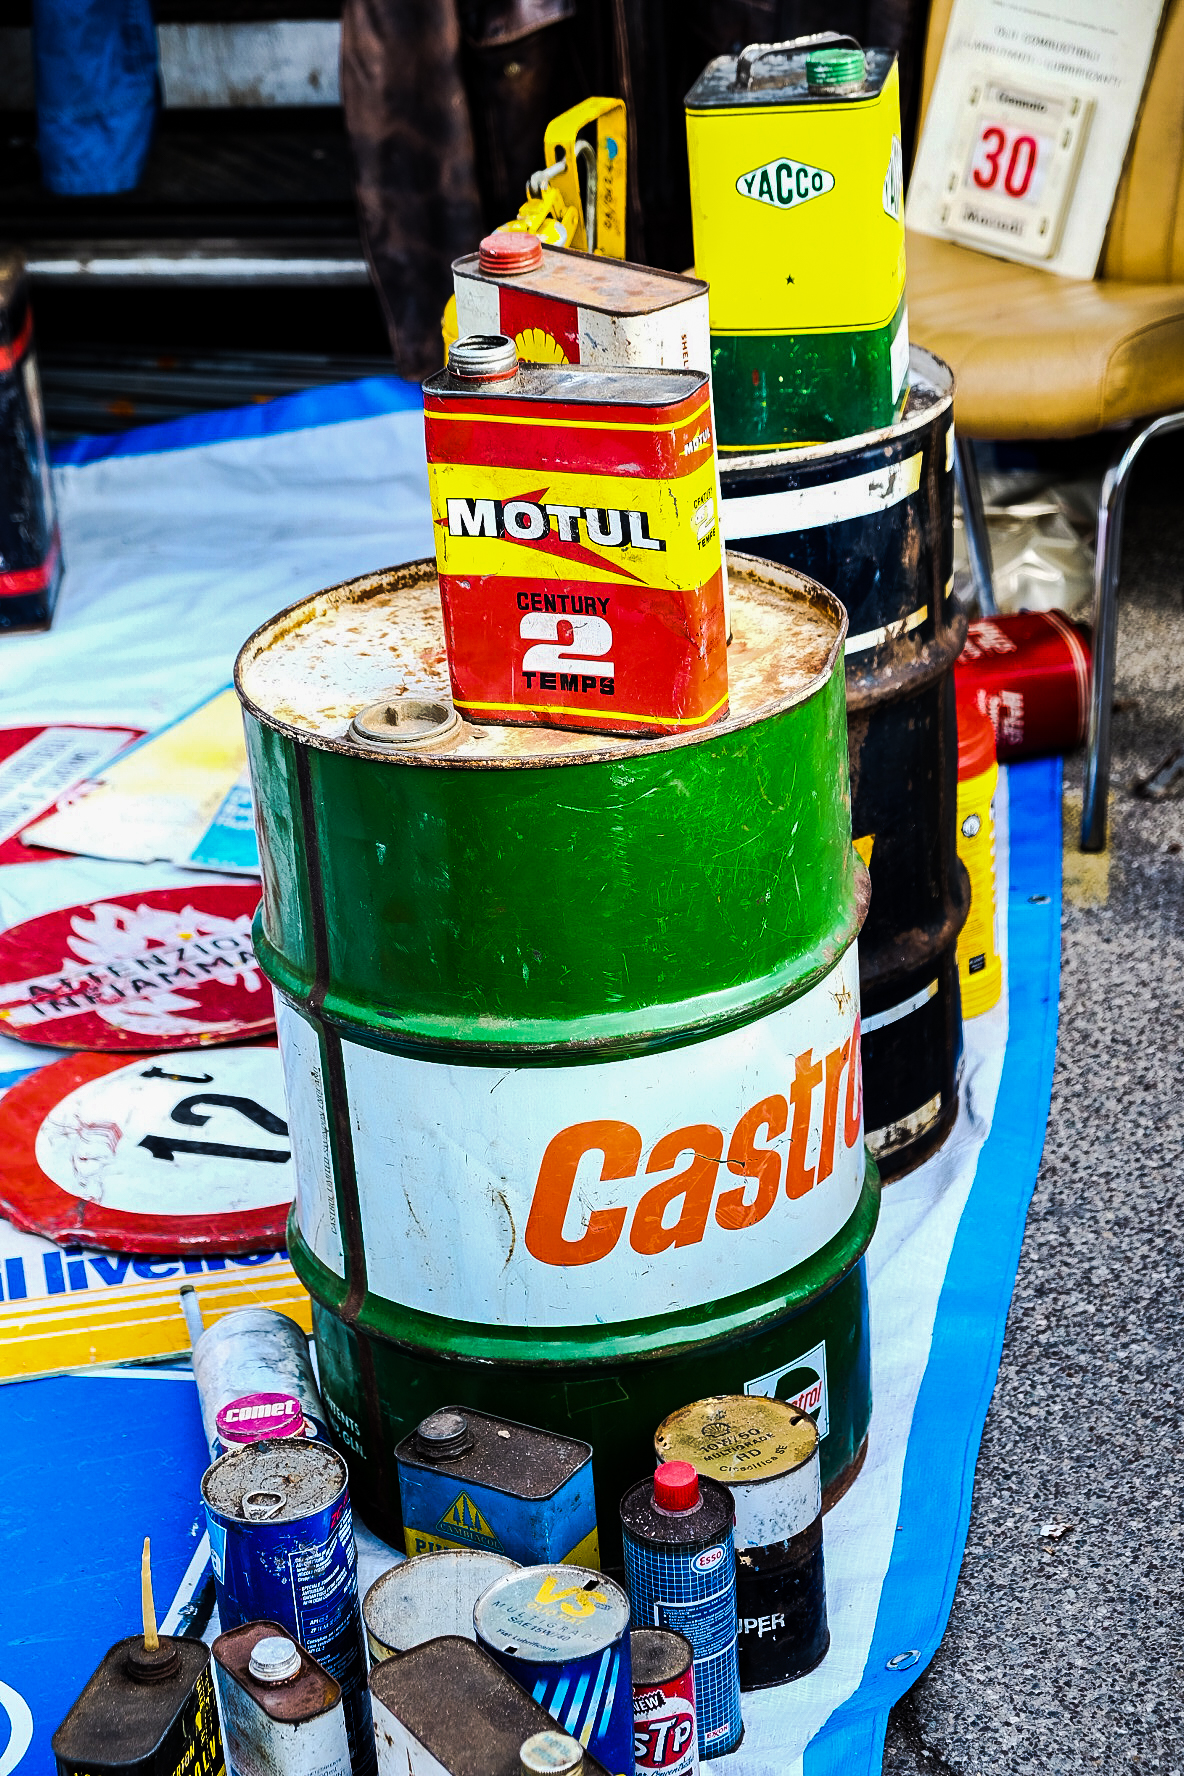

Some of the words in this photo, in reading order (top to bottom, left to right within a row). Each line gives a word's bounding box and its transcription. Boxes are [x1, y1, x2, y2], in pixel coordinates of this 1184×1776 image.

[973, 126, 1038, 199] 30
[744, 163, 824, 205] YACCO
[681, 334, 689, 369] SHEL
[684, 427, 711, 457] MOTUL
[445, 497, 667, 552] MOTUL
[516, 591, 611, 615] CENTURY
[519, 612, 615, 677] 2
[521, 671, 615, 696] TEMPS
[223, 1399, 297, 1423] comet
[736, 1449, 762, 1462] HD
[534, 1575, 608, 1617] VS
[635, 1717, 691, 1762] STP
